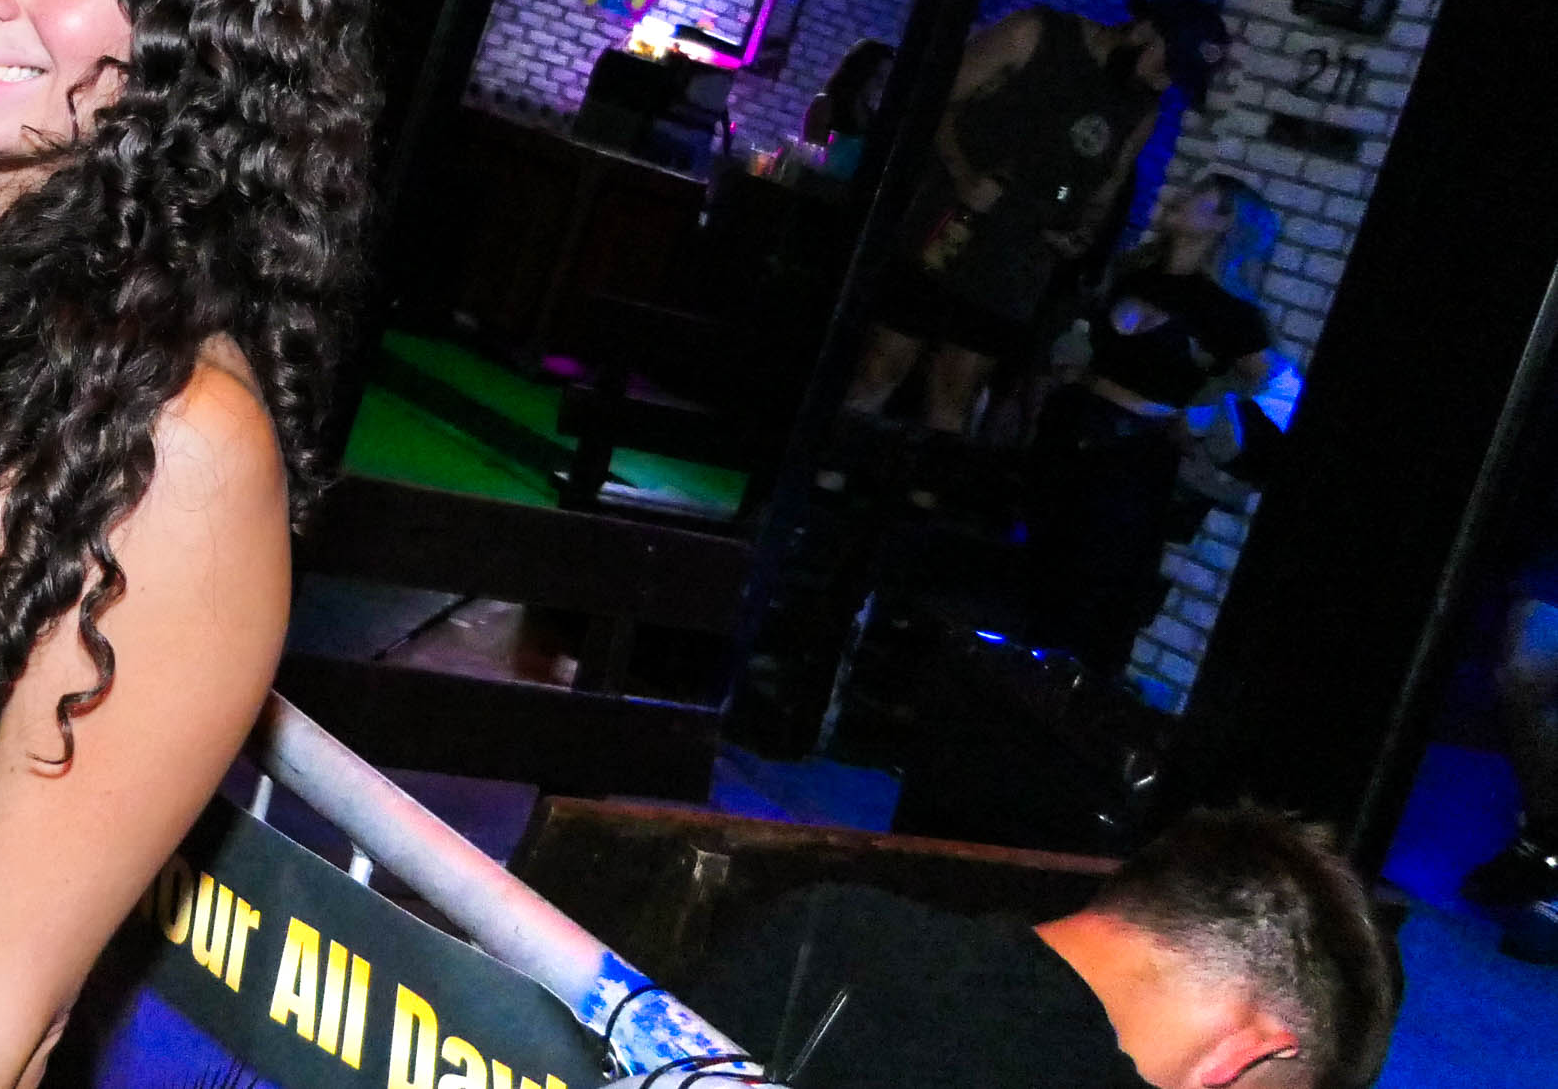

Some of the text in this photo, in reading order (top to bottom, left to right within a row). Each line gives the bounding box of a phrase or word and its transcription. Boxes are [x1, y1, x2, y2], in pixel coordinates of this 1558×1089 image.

[156, 856, 568, 1089] our All Da
